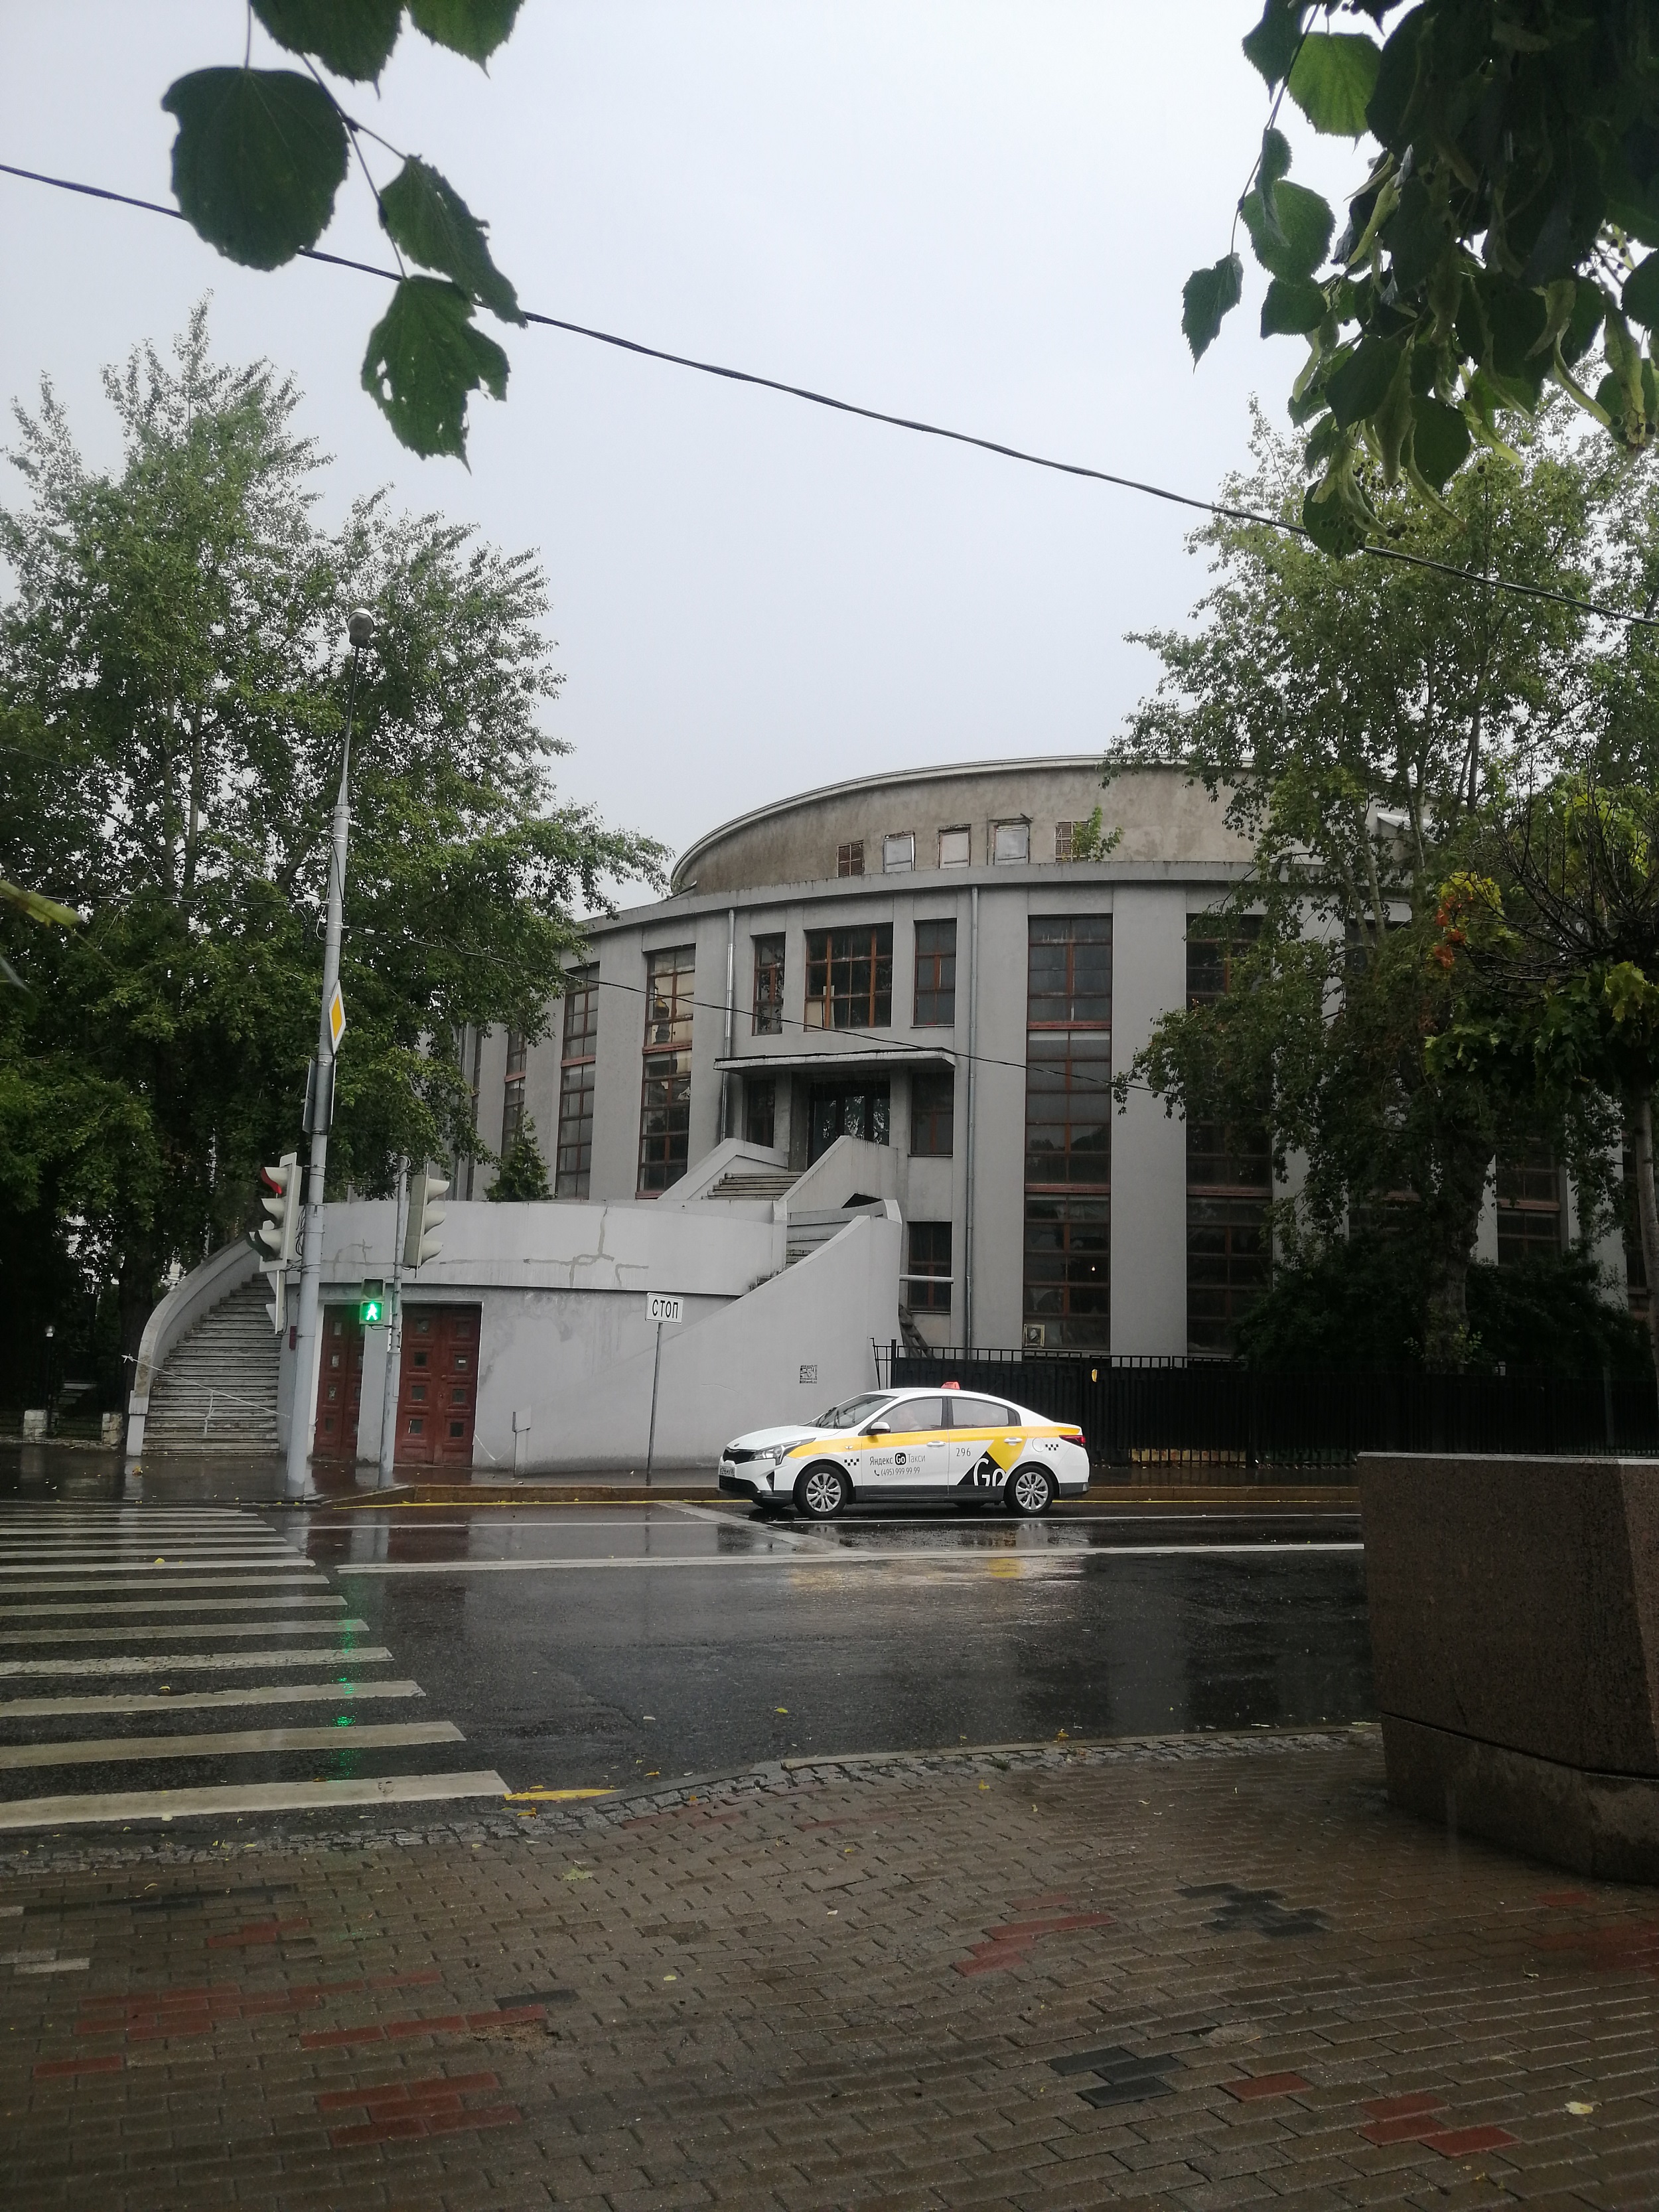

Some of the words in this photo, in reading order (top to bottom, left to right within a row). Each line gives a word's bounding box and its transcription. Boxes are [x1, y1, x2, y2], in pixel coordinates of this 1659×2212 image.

[652, 1299, 679, 1319] СТОП
[956, 1447, 971, 1457] 296
[869, 1456, 893, 1465] Яндекс
[895, 1453, 906, 1465] Go
[907, 1453, 926, 1463] Такси
